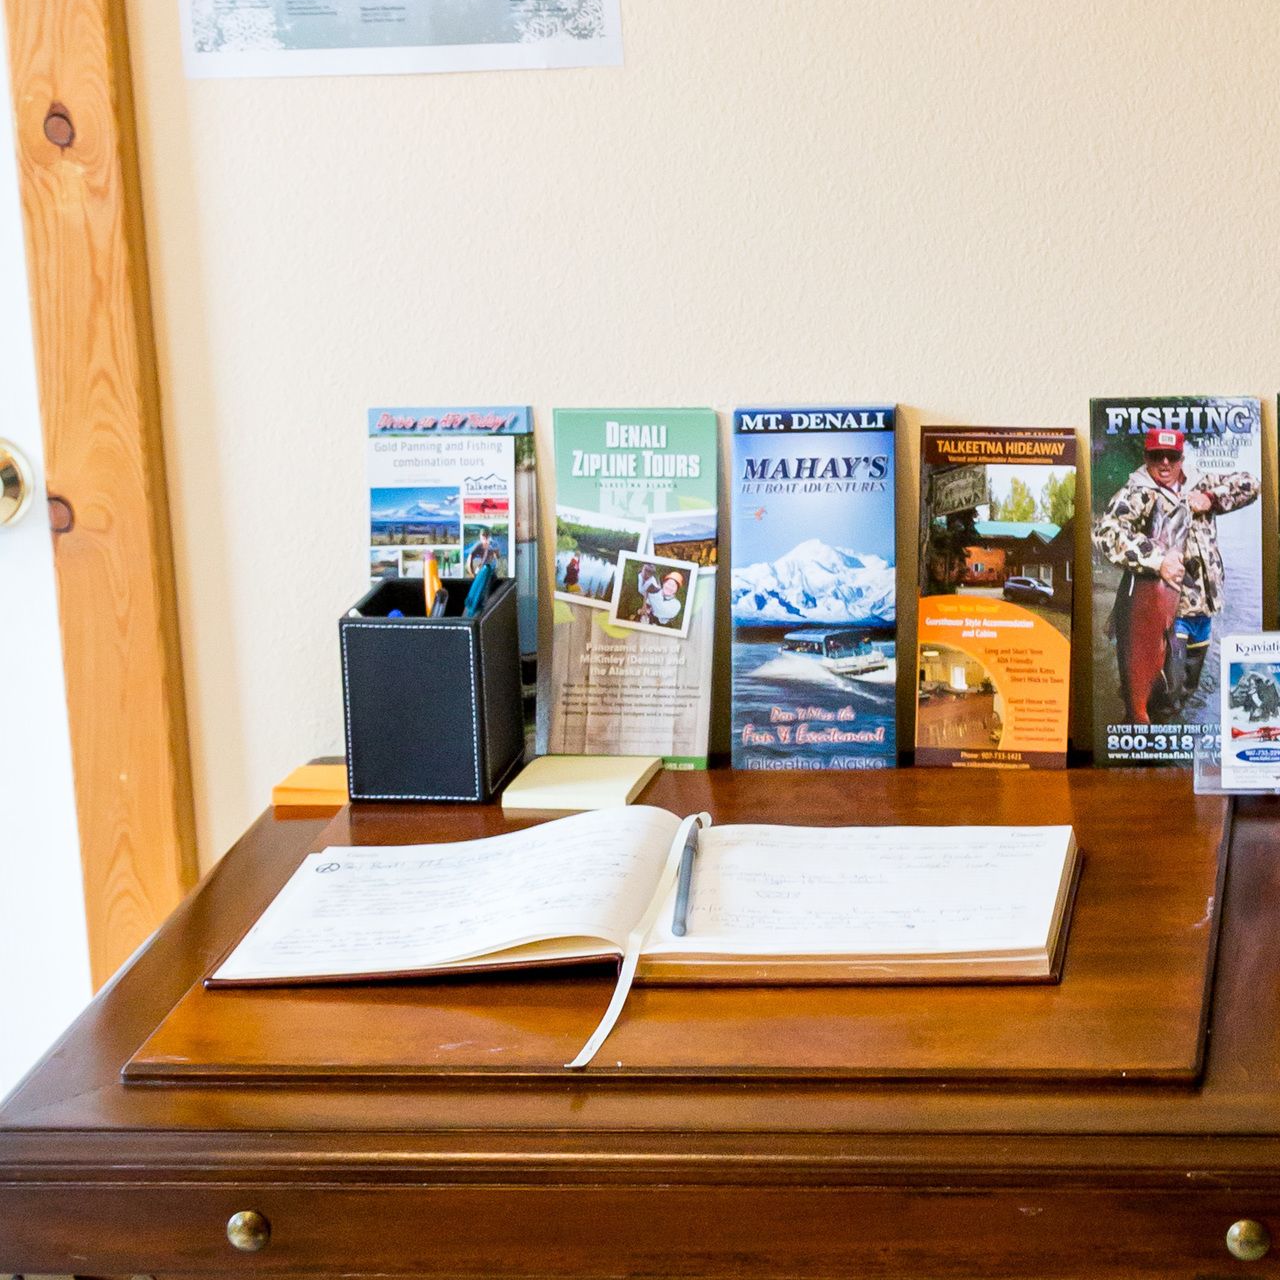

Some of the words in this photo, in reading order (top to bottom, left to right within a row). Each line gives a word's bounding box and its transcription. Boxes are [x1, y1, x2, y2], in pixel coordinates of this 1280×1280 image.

[741, 413, 785, 430] MT.
[791, 412, 885, 430] DENALI
[1105, 405, 1253, 436] FISHING
[605, 421, 667, 448] DENALI
[374, 440, 398, 452] Gold
[401, 441, 442, 454] Panning
[445, 441, 464, 451] and
[466, 440, 503, 454] Fishing
[936, 440, 1004, 454] TALKEETNA
[1005, 442, 1066, 455] HIDEAWAY
[393, 457, 457, 468] combination
[459, 457, 485, 467] tours
[571, 450, 637, 477] ZIPLINE
[641, 450, 701, 478] TOURS
[742, 455, 889, 481] MAHAY'S
[1107, 724, 1132, 734] CATCH
[1134, 724, 1149, 734] THE
[1183, 724, 1200, 734] FISH
